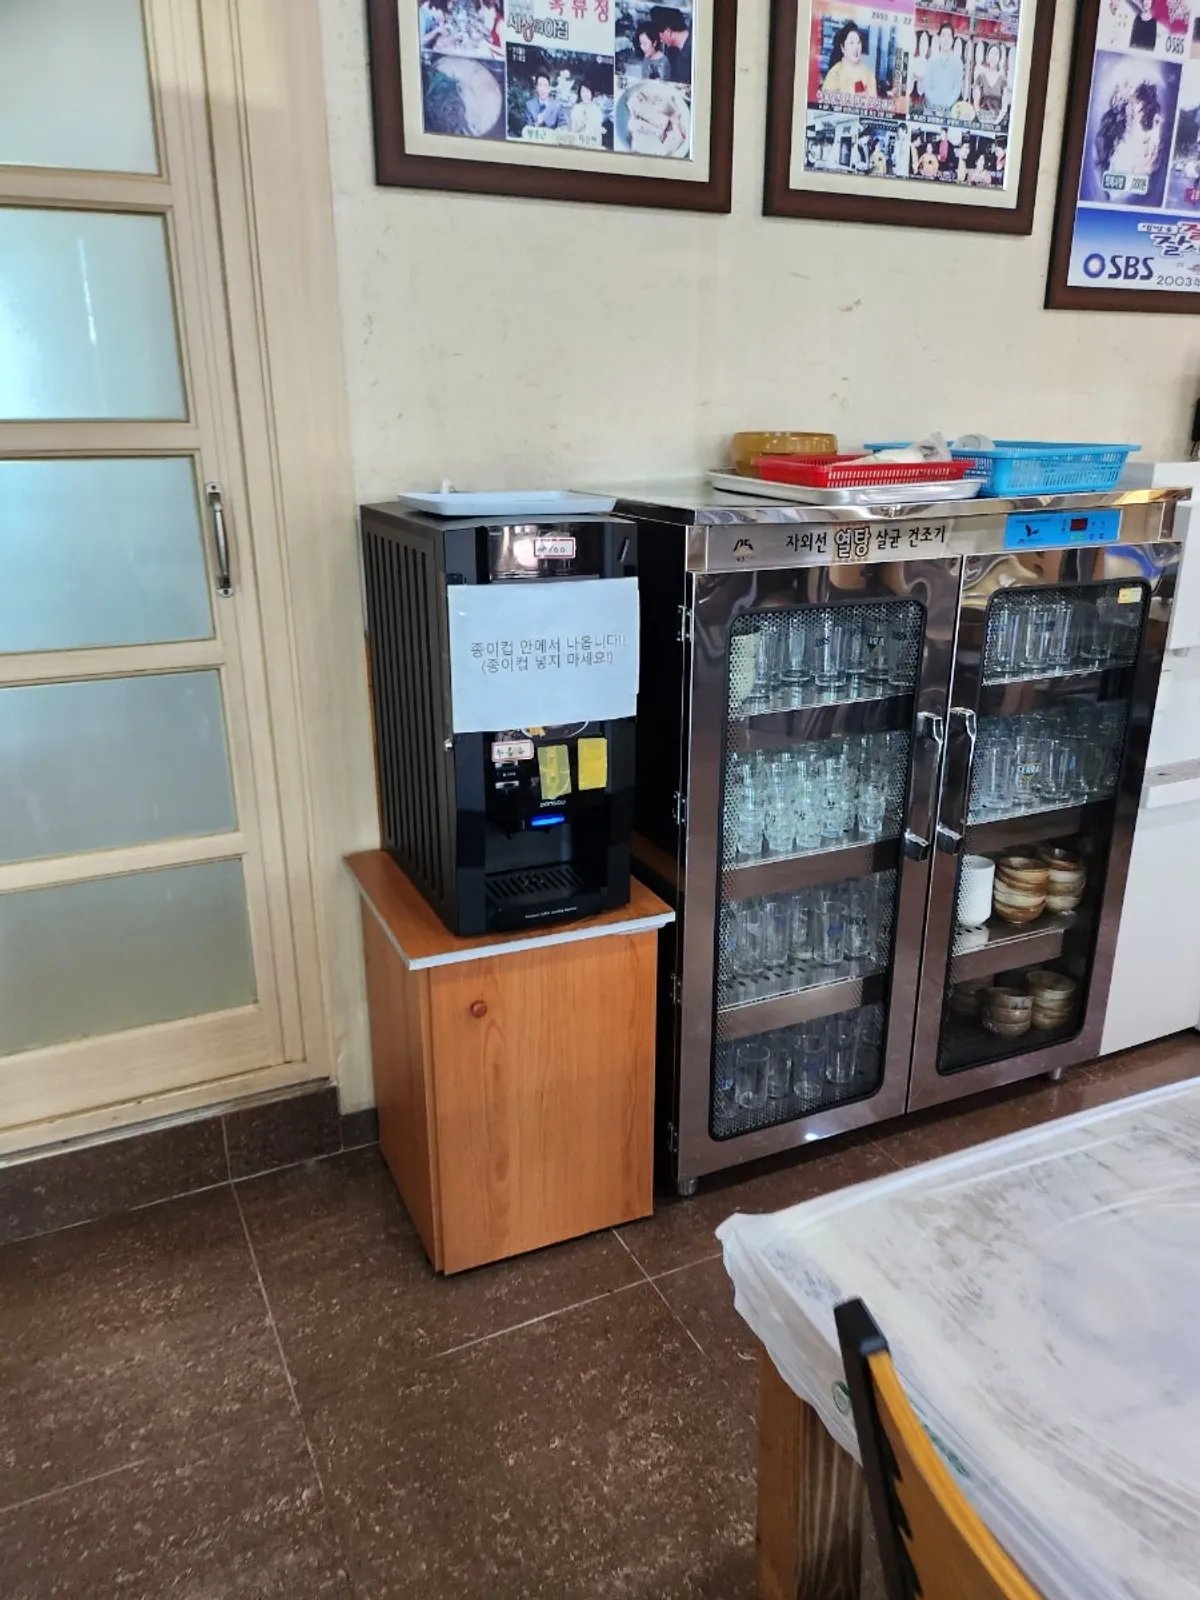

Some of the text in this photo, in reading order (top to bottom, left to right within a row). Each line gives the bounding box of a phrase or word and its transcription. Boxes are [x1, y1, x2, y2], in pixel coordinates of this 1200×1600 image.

[1108, 255, 1155, 280] SBS
[785, 526, 946, 559] 자외선 열탕 살균 건조기
[471, 640, 513, 658] 종이컵
[520, 637, 560, 655] 안에서
[481, 649, 613, 675] (종이컵 넣지 마세요!)
